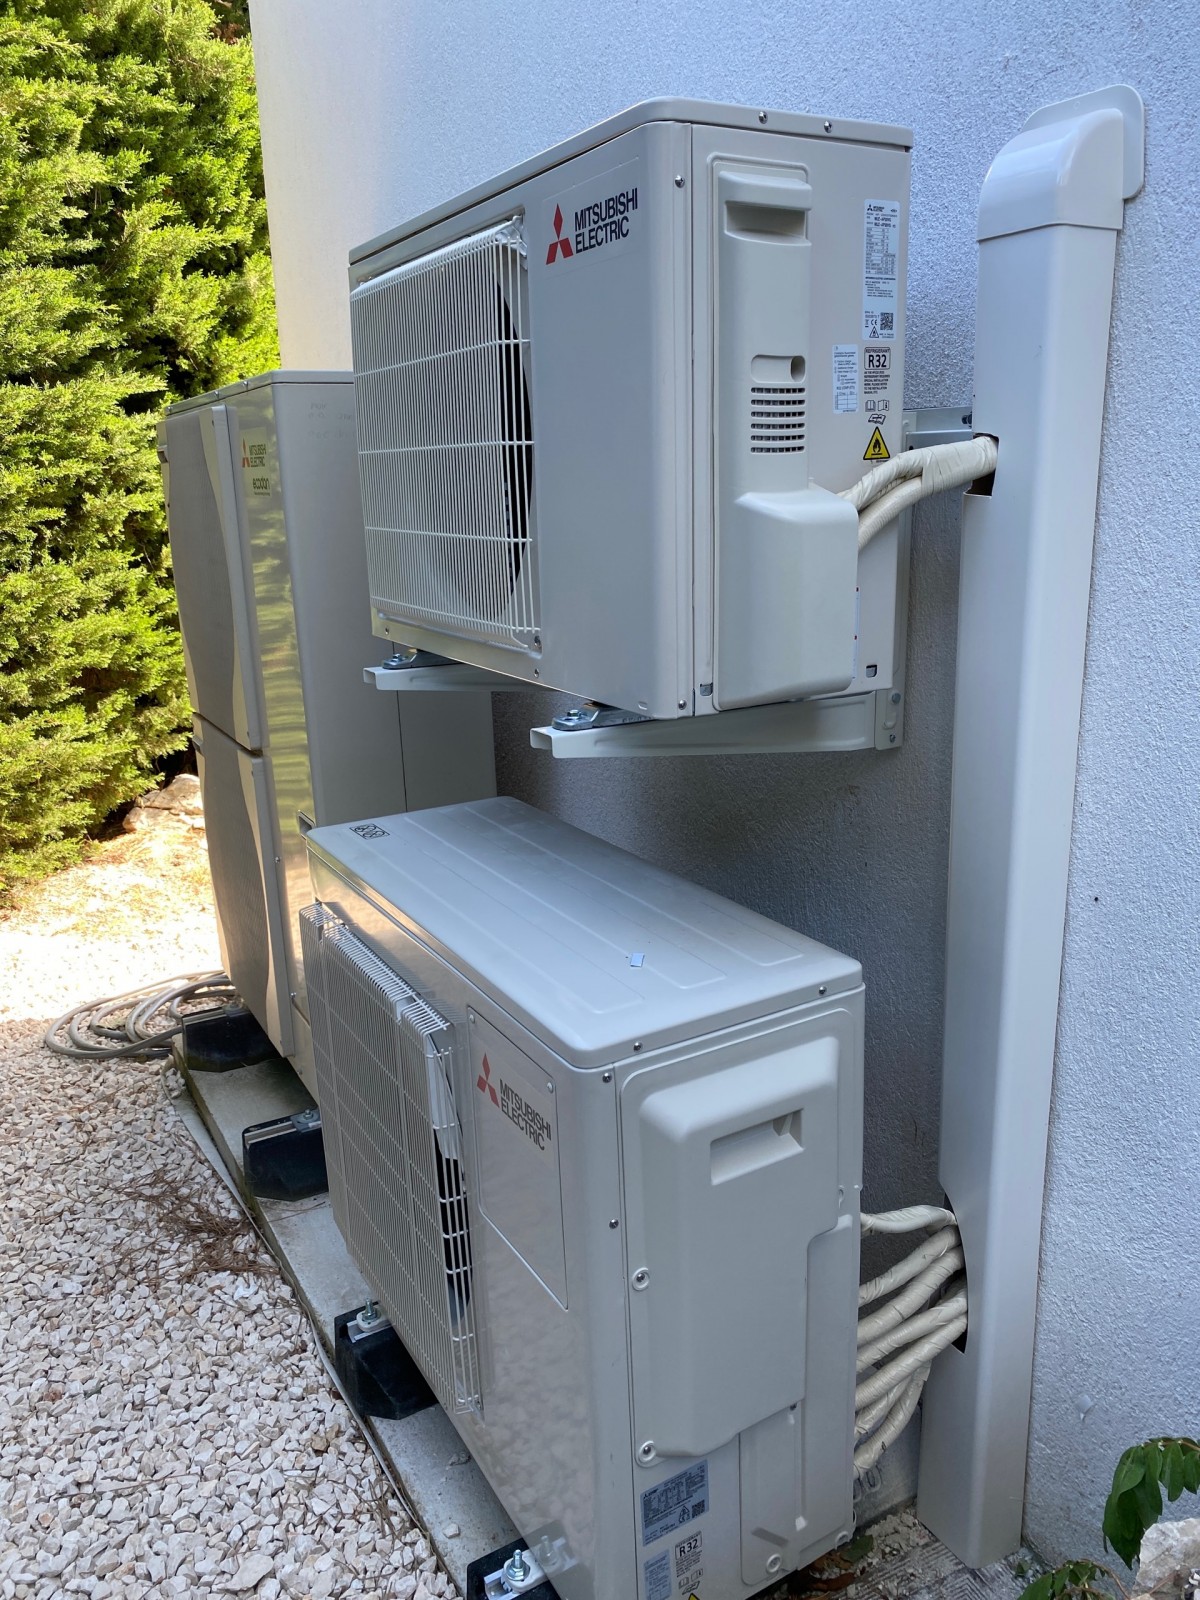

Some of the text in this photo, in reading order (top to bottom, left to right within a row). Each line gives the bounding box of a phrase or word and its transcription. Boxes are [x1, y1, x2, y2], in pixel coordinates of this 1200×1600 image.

[575, 187, 638, 232] MITSUBISHI
[575, 215, 630, 254] ELECTRIC
[868, 354, 887, 368] R32
[249, 444, 267, 456] MITSUBISHI
[250, 456, 265, 468] ELECTRIC
[500, 1078, 552, 1141] MITSUBISHI
[501, 1096, 545, 1151] ELECTRIC
[679, 1538, 699, 1557] R32
